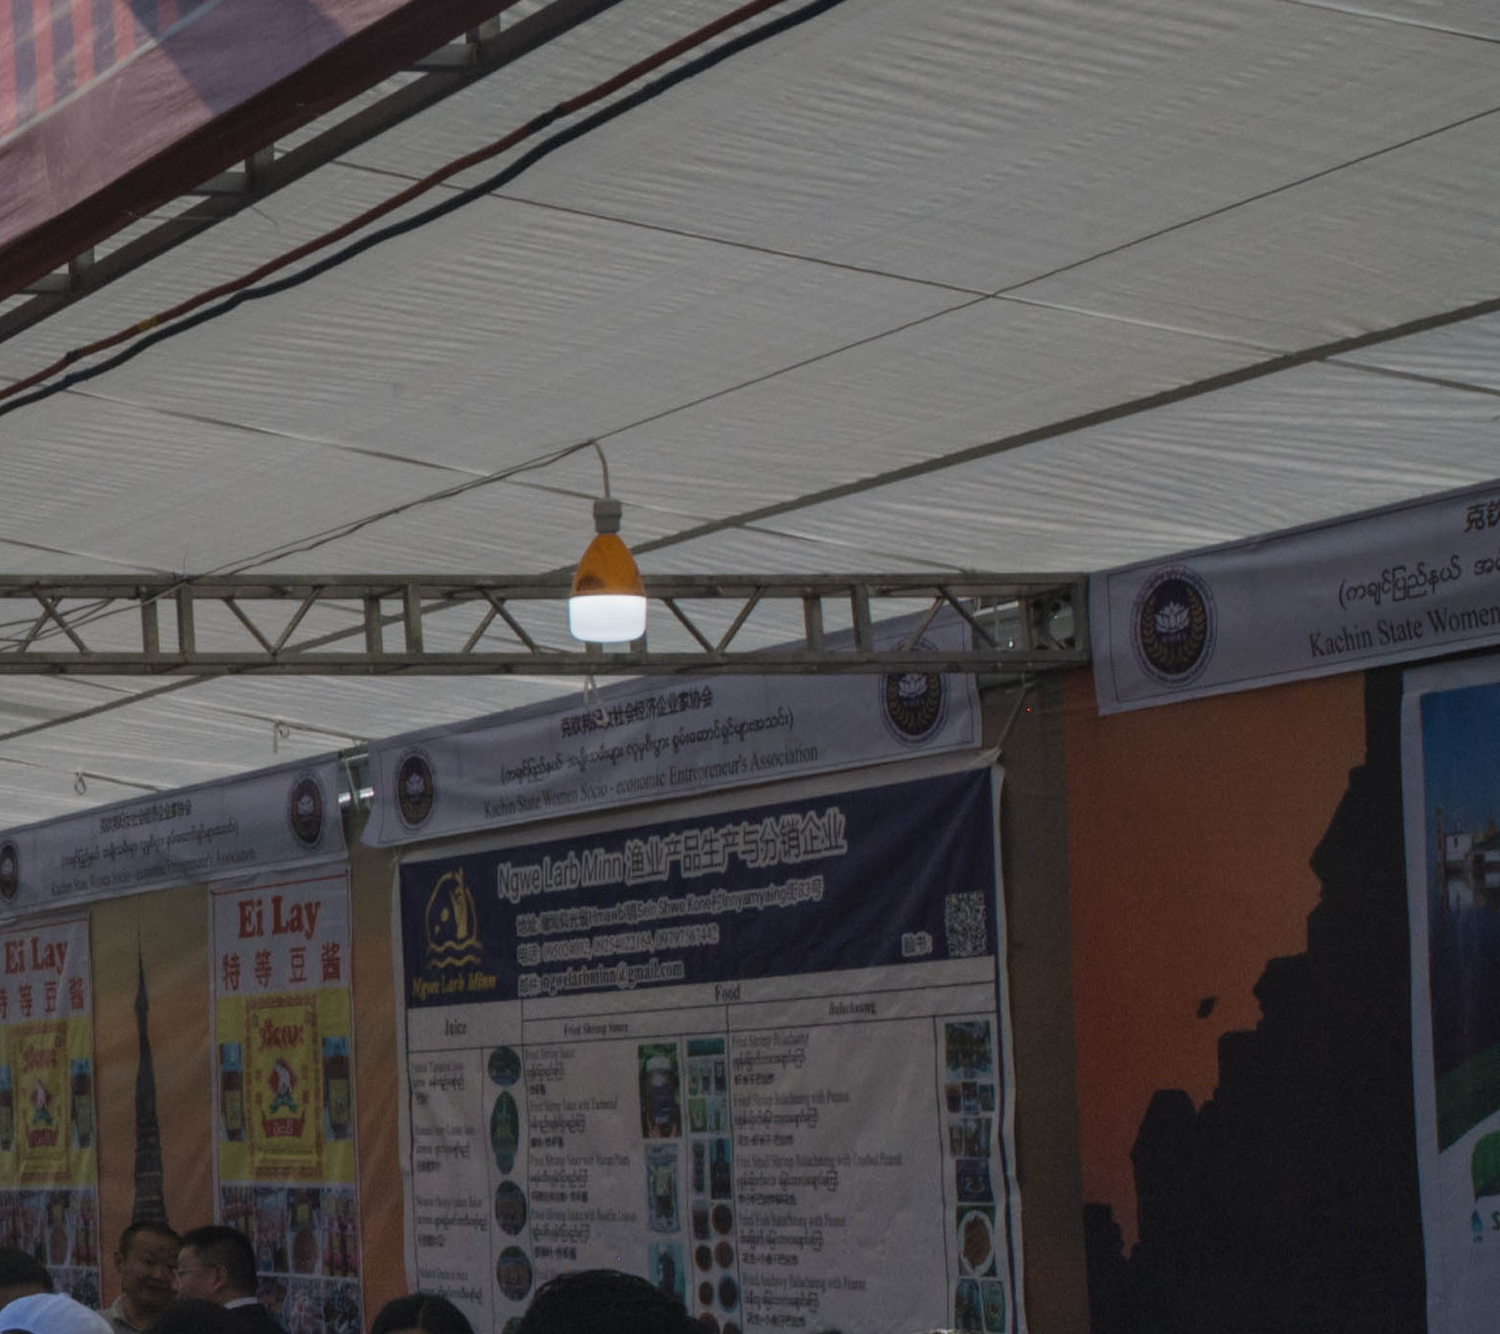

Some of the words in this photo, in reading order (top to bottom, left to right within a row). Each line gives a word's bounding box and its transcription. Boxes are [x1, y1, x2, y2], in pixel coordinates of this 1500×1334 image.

[1308, 628, 1373, 658] Kachin
[1376, 617, 1424, 647] State
[750, 745, 818, 772] Association
[497, 861, 541, 903] Ngwe
[543, 851, 580, 893] Larb
[581, 847, 624, 887] Minn
[625, 807, 847, 886] 渔业产品生产与分销企业
[238, 901, 264, 939] Ei
[271, 896, 322, 940] Lay
[4, 941, 25, 975] Ei
[30, 937, 69, 976] Lay
[222, 942, 342, 991] 特等豆酱
[714, 984, 742, 1002] Food
